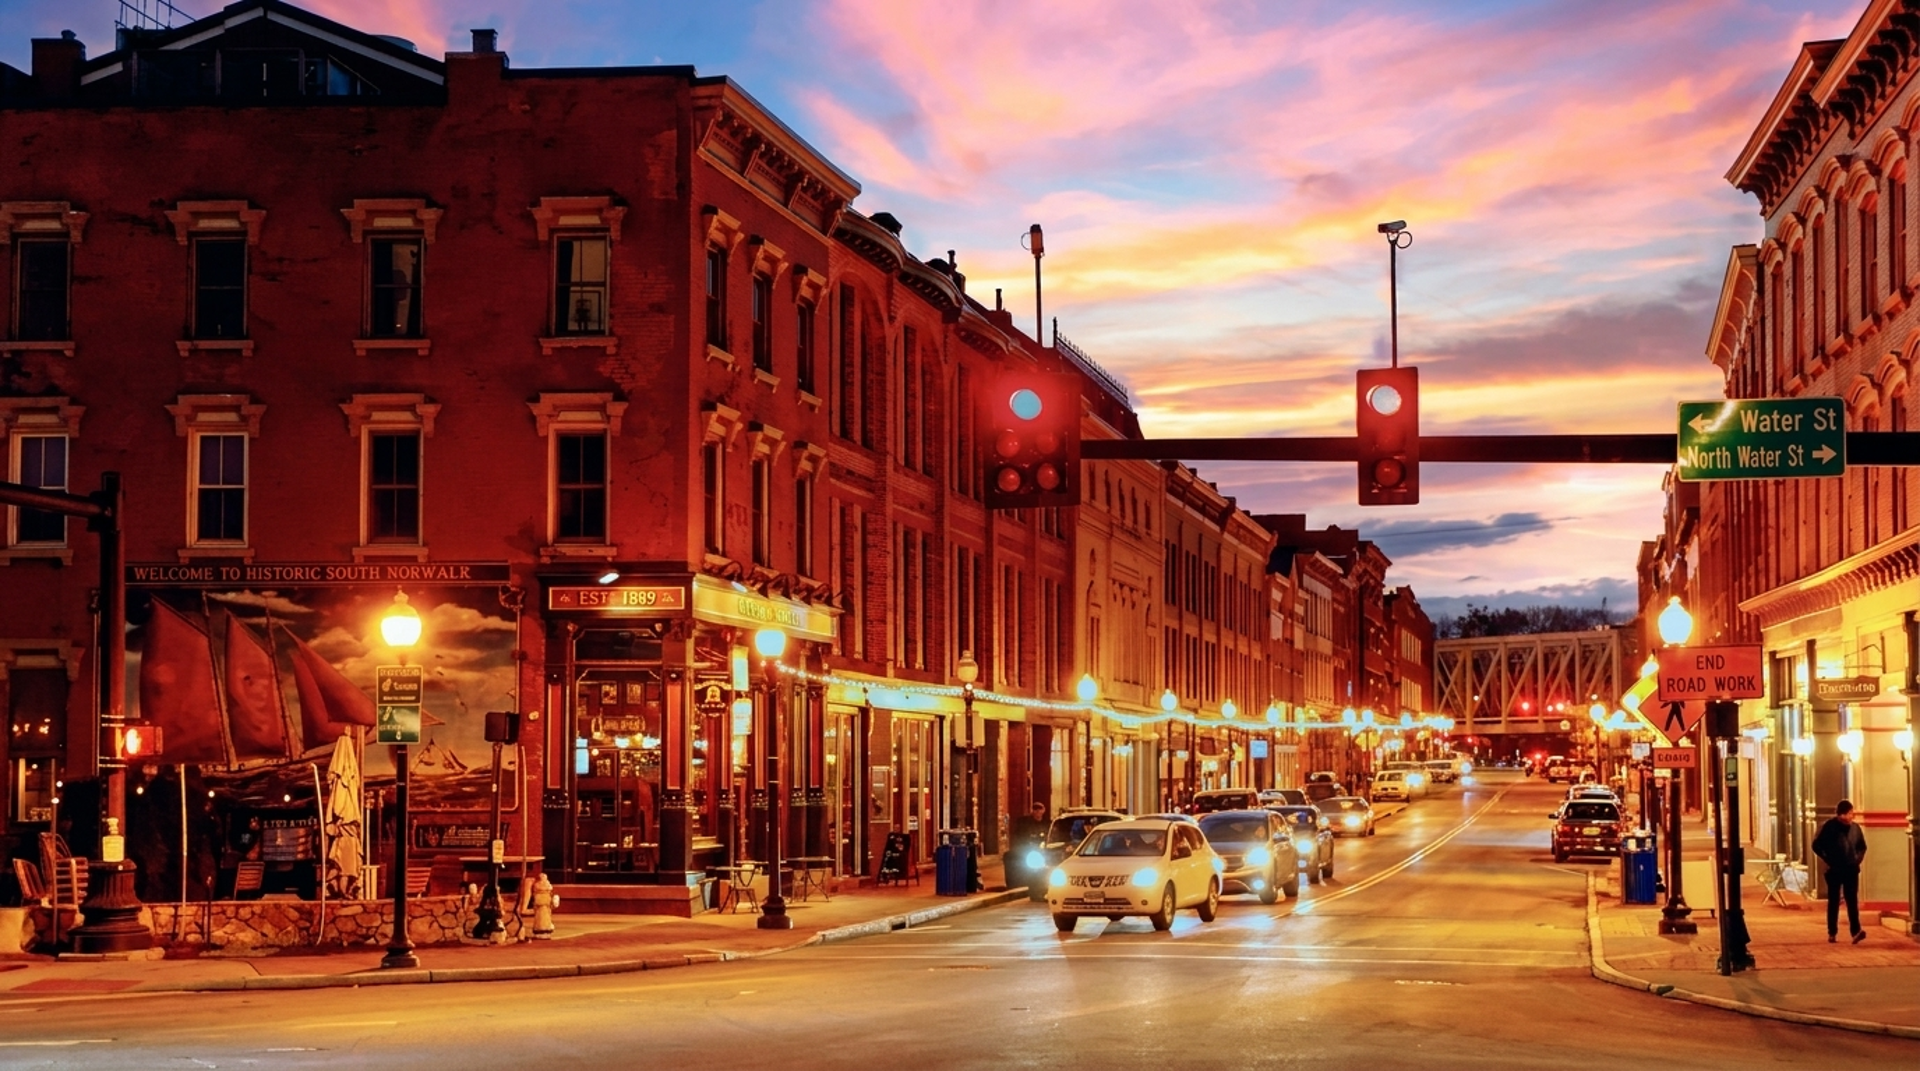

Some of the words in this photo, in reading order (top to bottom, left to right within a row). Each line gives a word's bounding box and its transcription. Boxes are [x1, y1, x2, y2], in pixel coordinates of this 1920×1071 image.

[1740, 409, 1803, 433] Water
[1813, 407, 1837, 431] St
[1687, 445, 1731, 469] North
[1737, 445, 1782, 468] Water
[1788, 444, 1804, 467] St
[134, 567, 214, 580] WELCOME
[220, 567, 241, 580] TO
[246, 567, 321, 580] HISTORIC
[326, 566, 380, 580] SOUTH
[387, 566, 471, 579] NORWALK
[623, 591, 656, 605] 1889
[1696, 655, 1725, 670] END
[1667, 677, 1706, 693] ROAD
[1715, 675, 1756, 691] WORK
